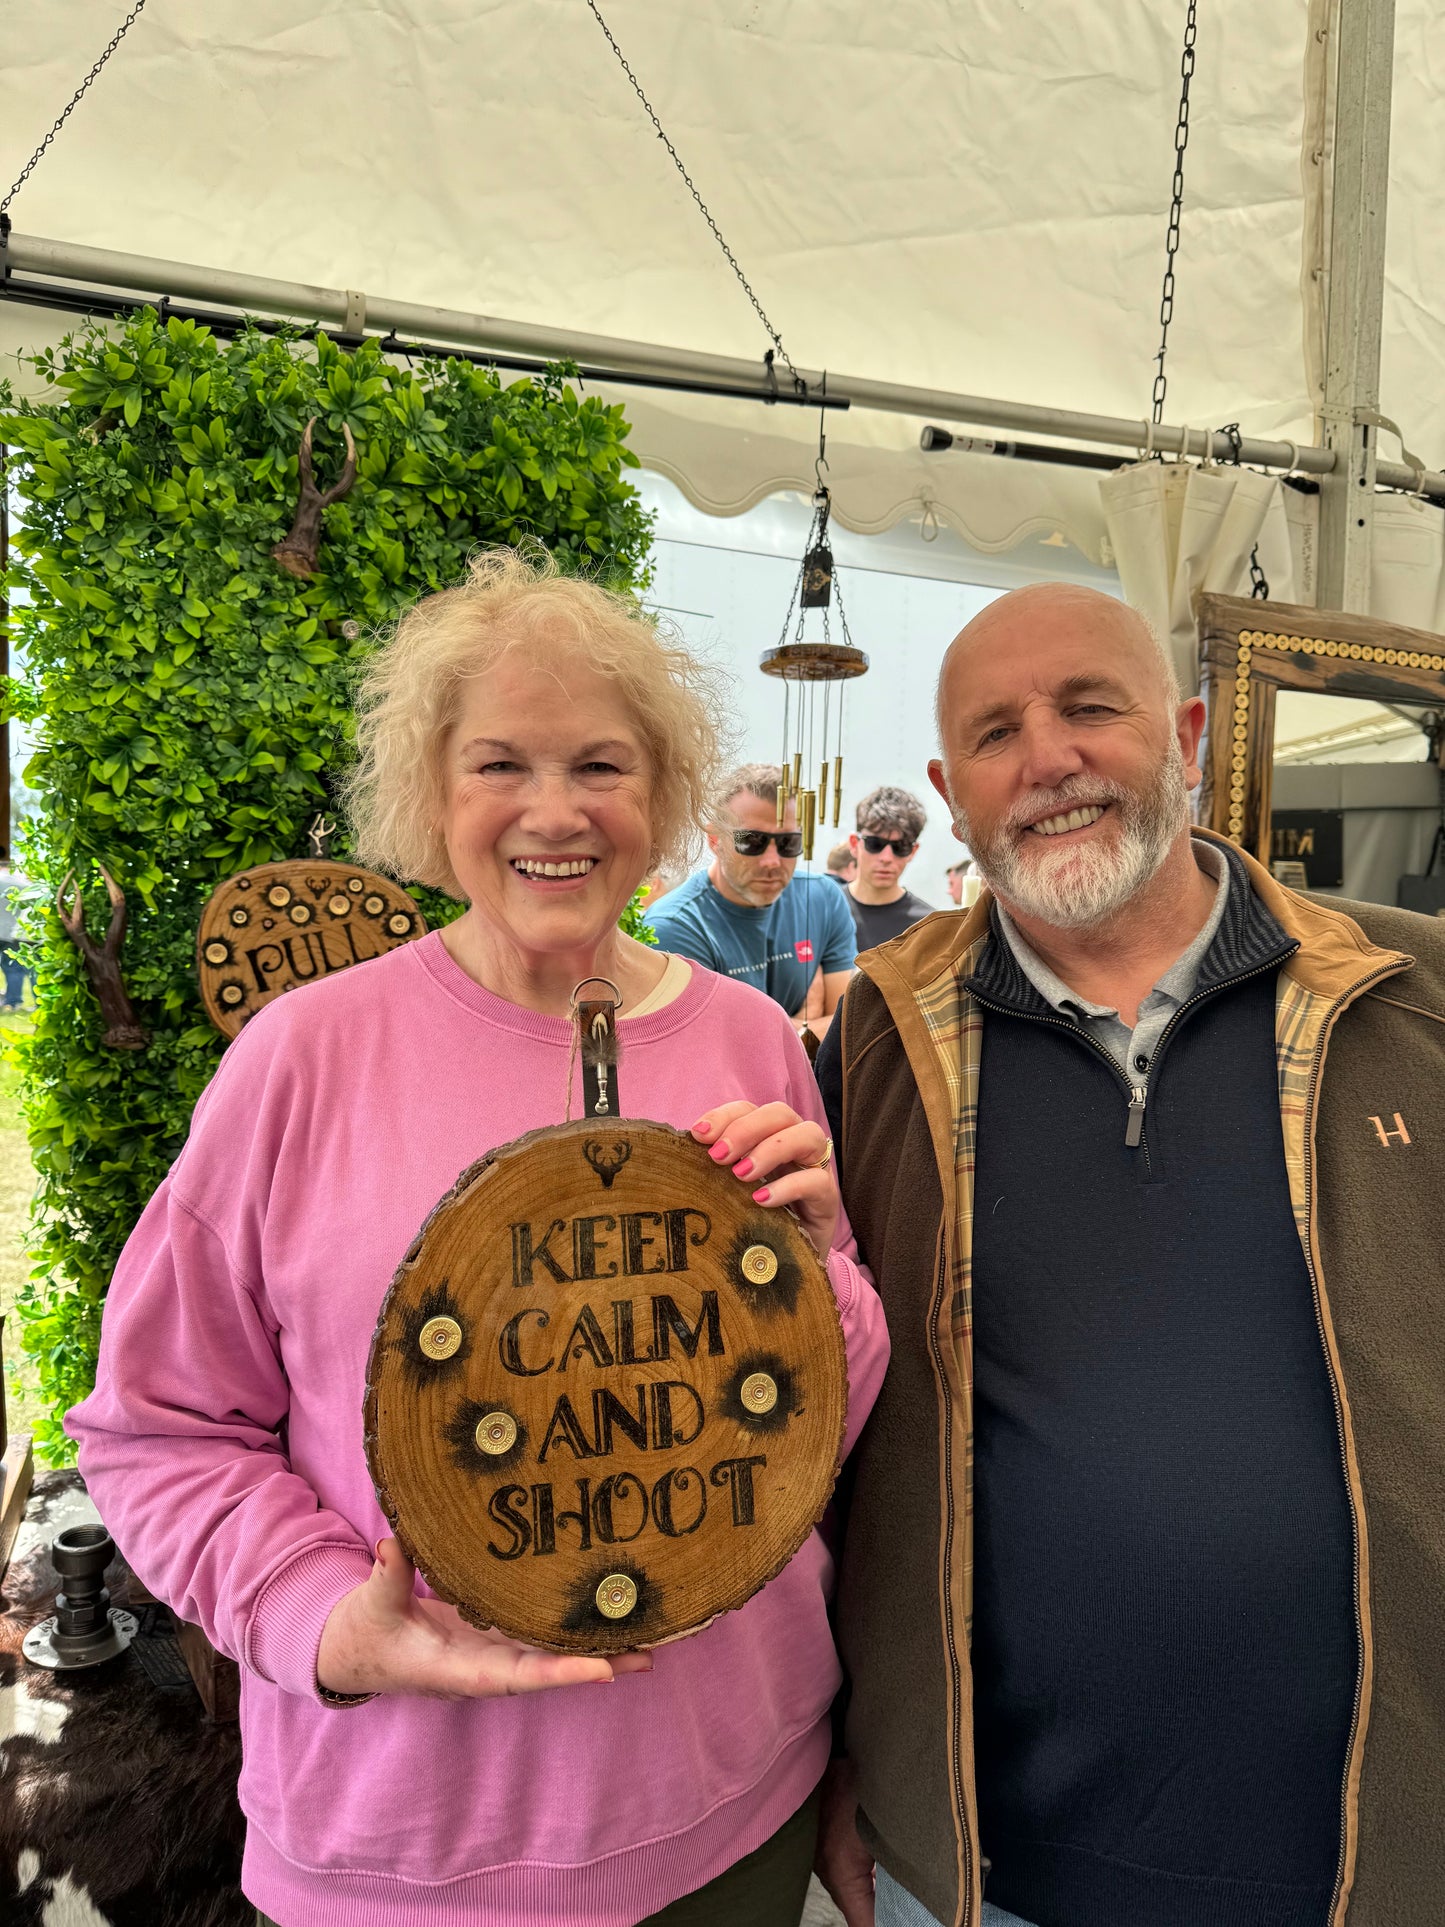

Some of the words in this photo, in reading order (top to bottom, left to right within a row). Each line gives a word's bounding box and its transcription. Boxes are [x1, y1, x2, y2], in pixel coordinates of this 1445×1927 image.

[245, 923, 379, 993] PULL
[1367, 1112, 1411, 1147] H
[510, 1207, 713, 1288] KEEP
[500, 1290, 725, 1377] CALM
[538, 1380, 705, 1464] AND
[487, 1455, 767, 1561] SHOOT
